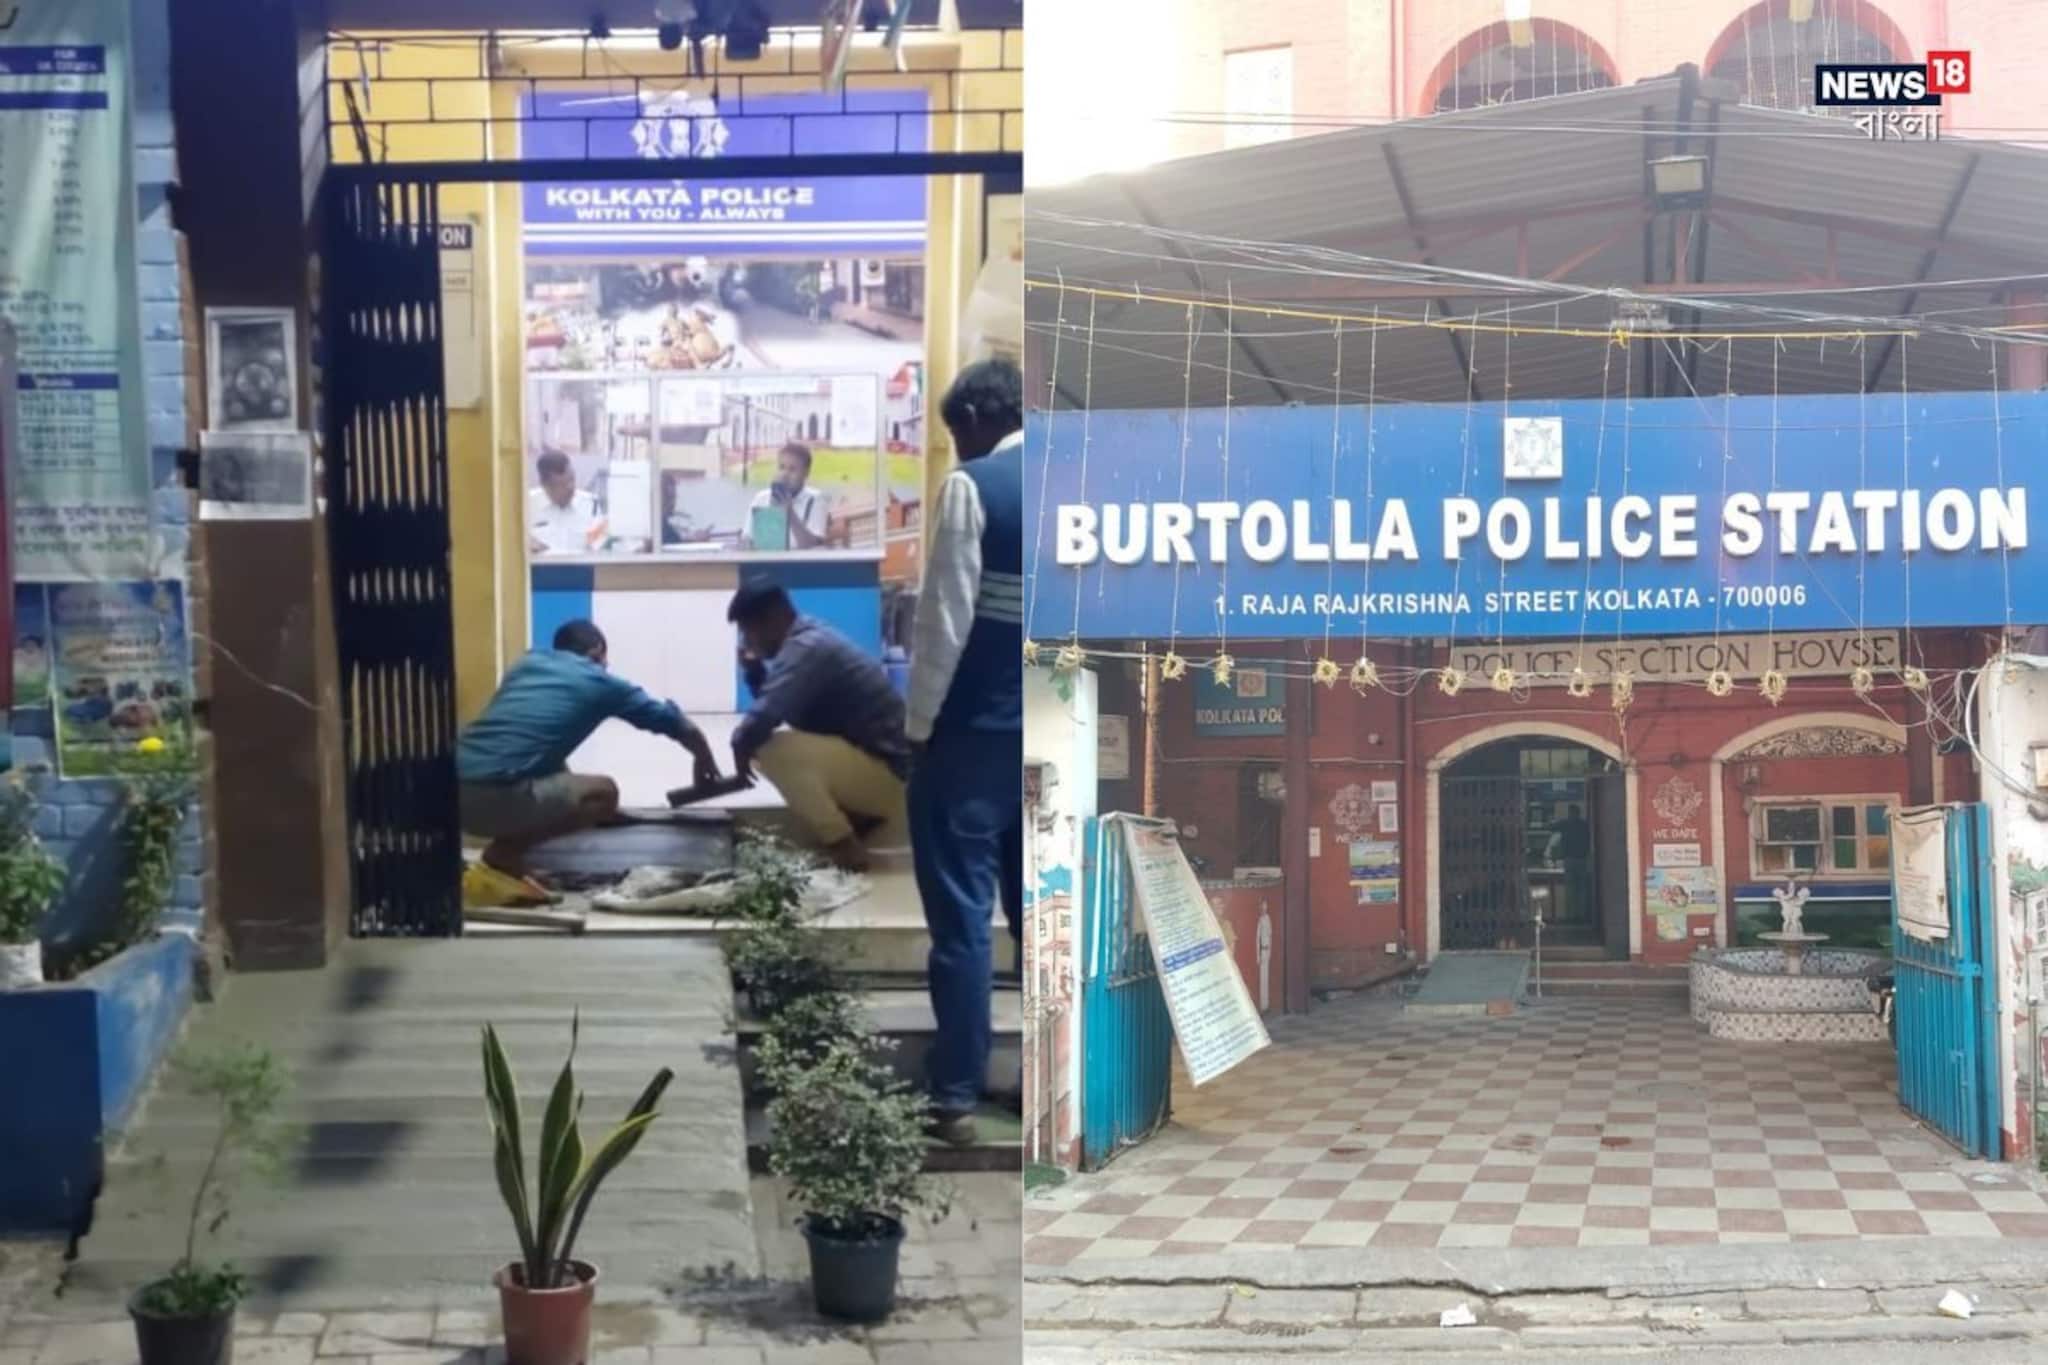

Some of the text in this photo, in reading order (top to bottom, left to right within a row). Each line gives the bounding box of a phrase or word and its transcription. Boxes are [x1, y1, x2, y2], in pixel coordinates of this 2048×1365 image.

[546, 187, 815, 206] KOLKATA POLICE
[577, 207, 631, 220] WITH
[638, 207, 681, 220] YOU
[700, 206, 785, 220] ALWAYS
[1055, 486, 2030, 566] BURTOLLA POLICE STATION
[1243, 596, 1308, 615] RAJA
[1314, 592, 1471, 615] RAJKRISHNA
[1484, 590, 1579, 613] STREET
[1586, 587, 1702, 611] KOLKATA
[1723, 585, 1807, 607] 700006
[1464, 650, 1574, 679] POLICE
[1597, 642, 1751, 676] SECTION
[1196, 708, 1257, 725] KOLKATA
